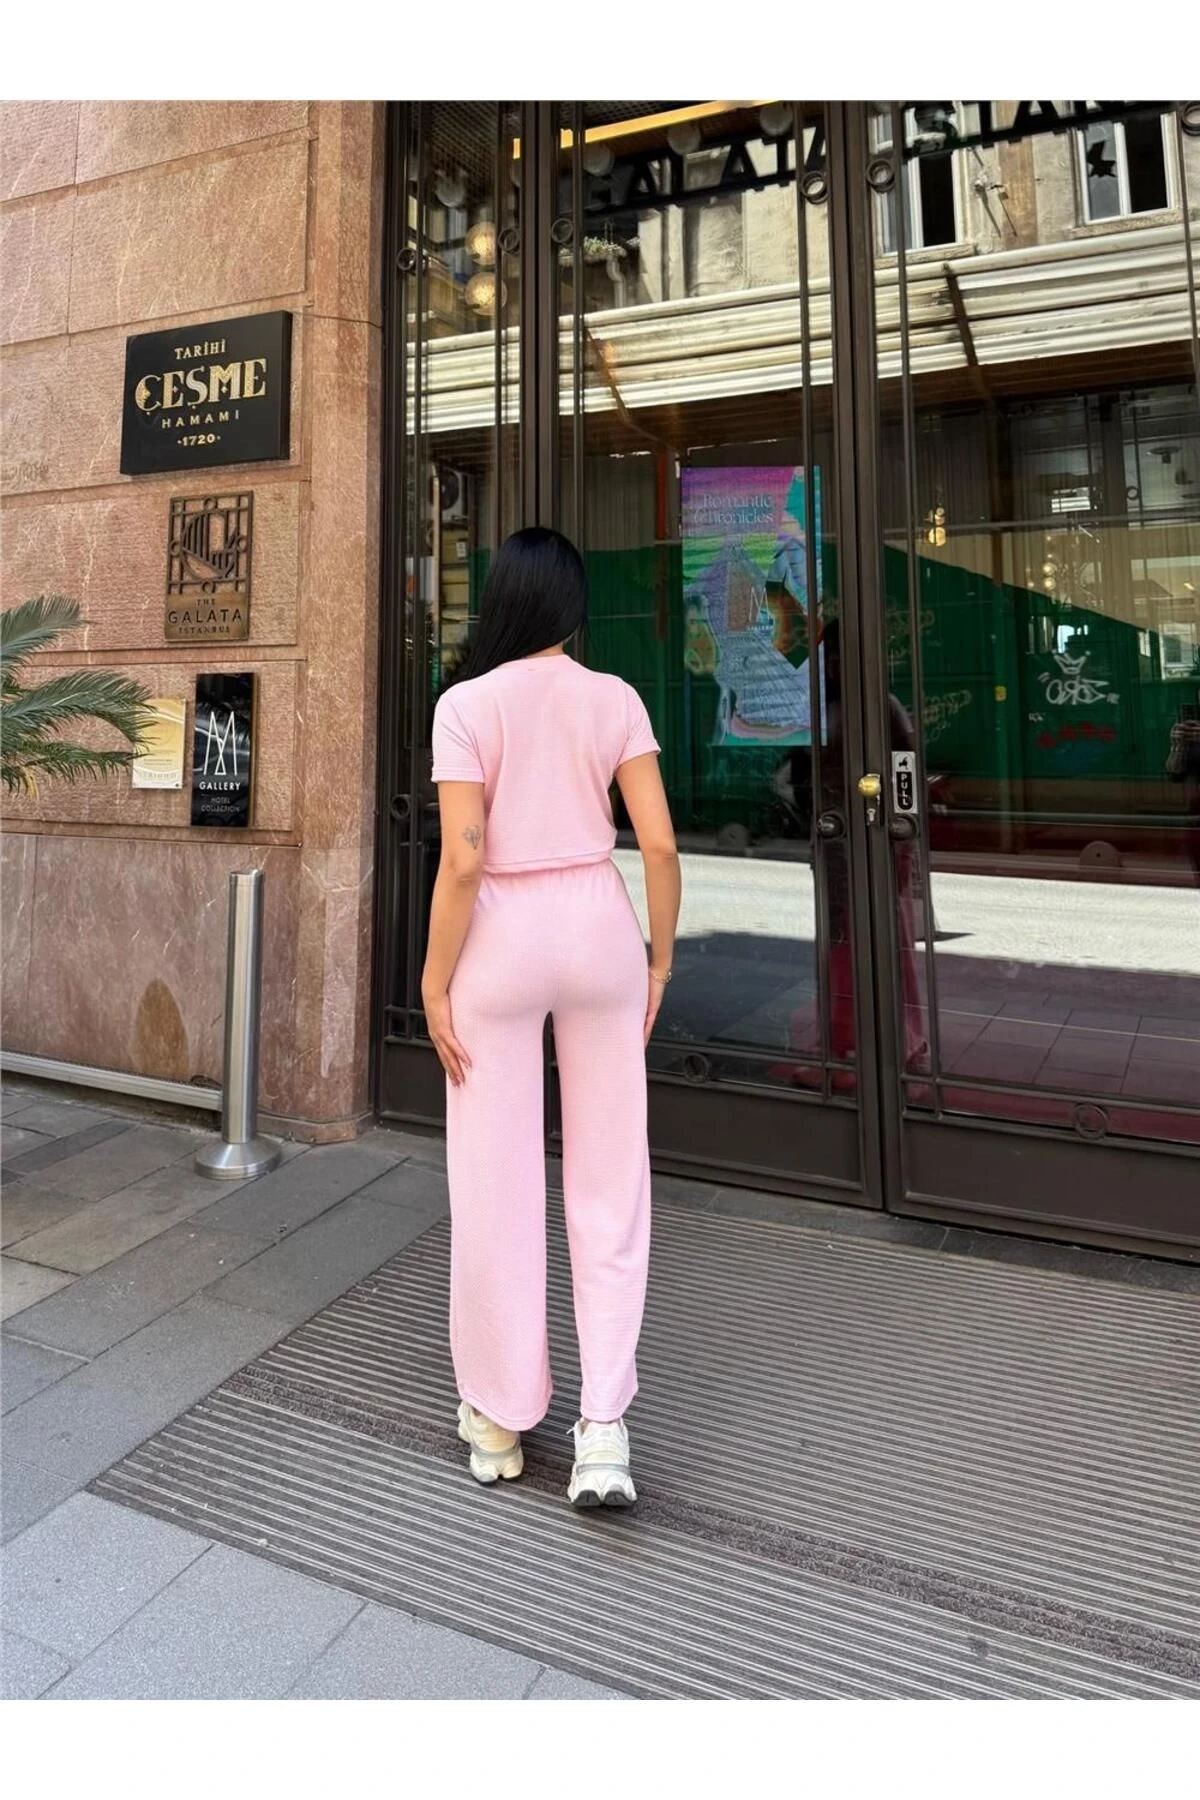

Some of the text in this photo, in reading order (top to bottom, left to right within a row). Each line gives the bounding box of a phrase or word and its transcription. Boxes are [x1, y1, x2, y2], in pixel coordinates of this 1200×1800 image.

[174, 339, 226, 360] TARİHİ
[135, 358, 267, 415] ÇEŞME
[161, 409, 239, 429] HAMAMI
[703, 494, 772, 508] Romantic
[694, 508, 775, 524] Chronicles
[168, 608, 242, 624] GALATA
[199, 781, 241, 791] GALLERY
[900, 773, 909, 806] PULL
[211, 796, 230, 804] HOTEL
